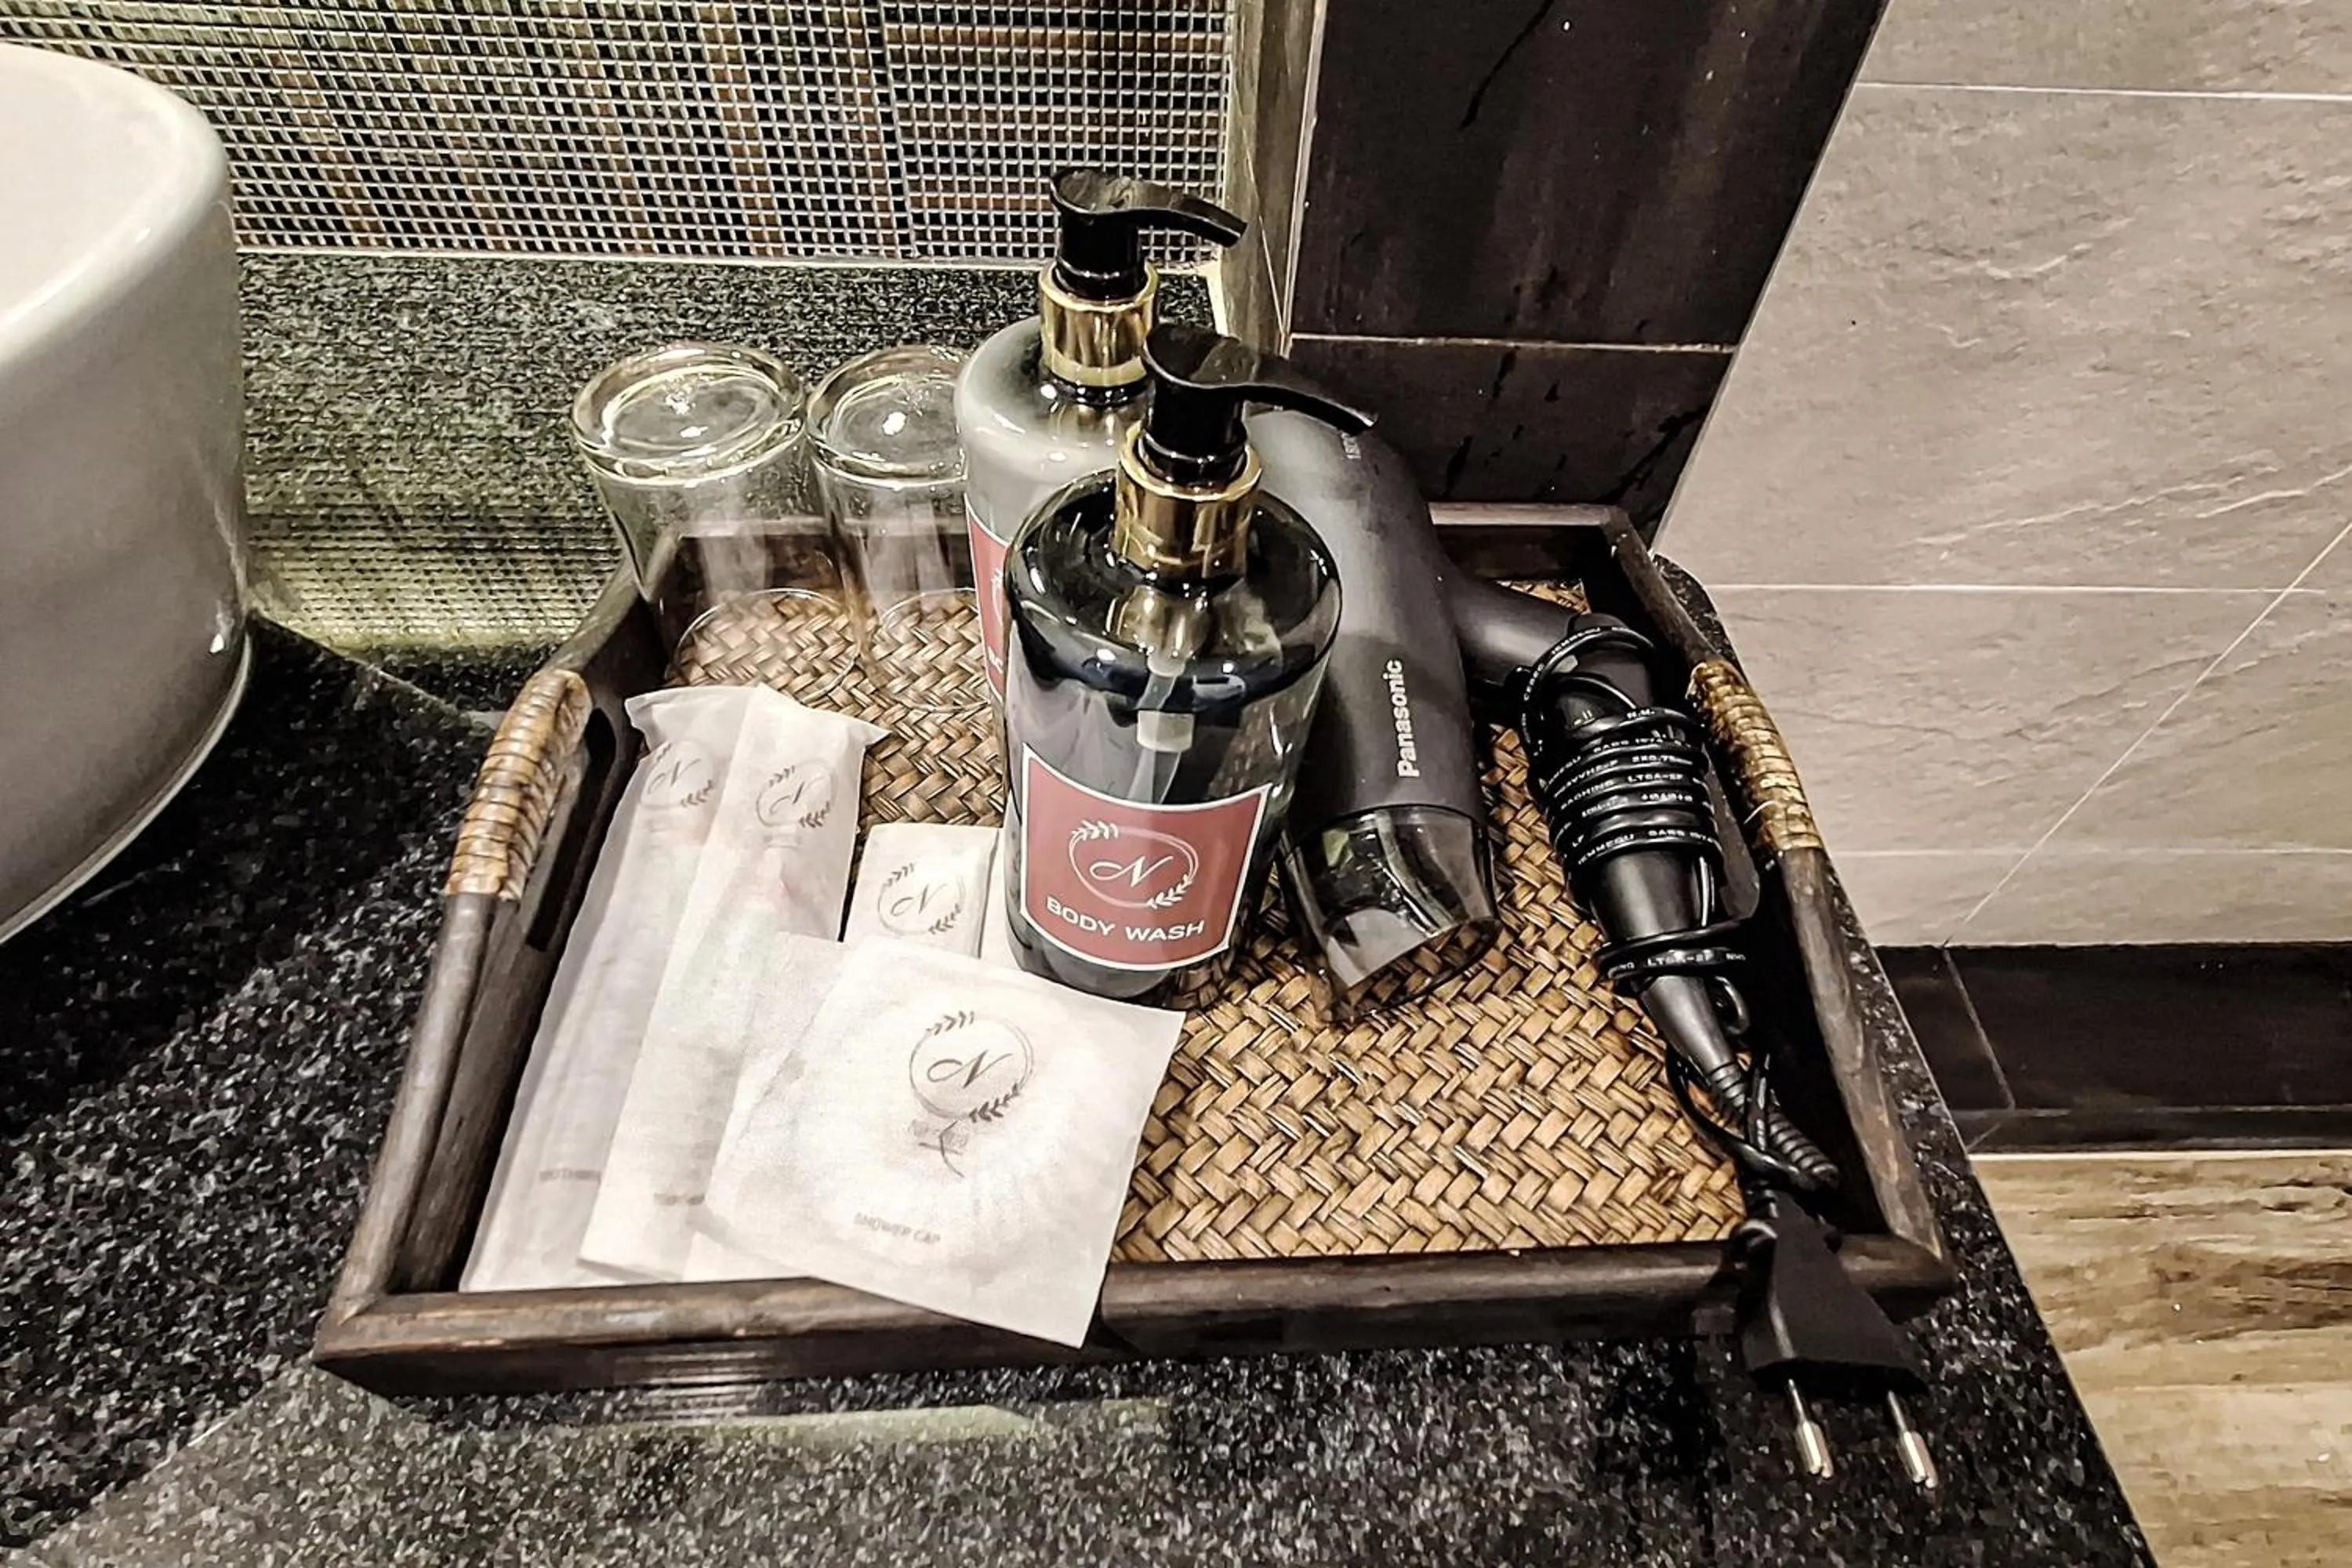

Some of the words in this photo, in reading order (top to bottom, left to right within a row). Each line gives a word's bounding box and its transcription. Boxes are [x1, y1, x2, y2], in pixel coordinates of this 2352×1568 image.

[1383, 659, 1420, 777] Panasonic
[1046, 896, 1115, 936] BODY
[1124, 919, 1205, 942] WASH
